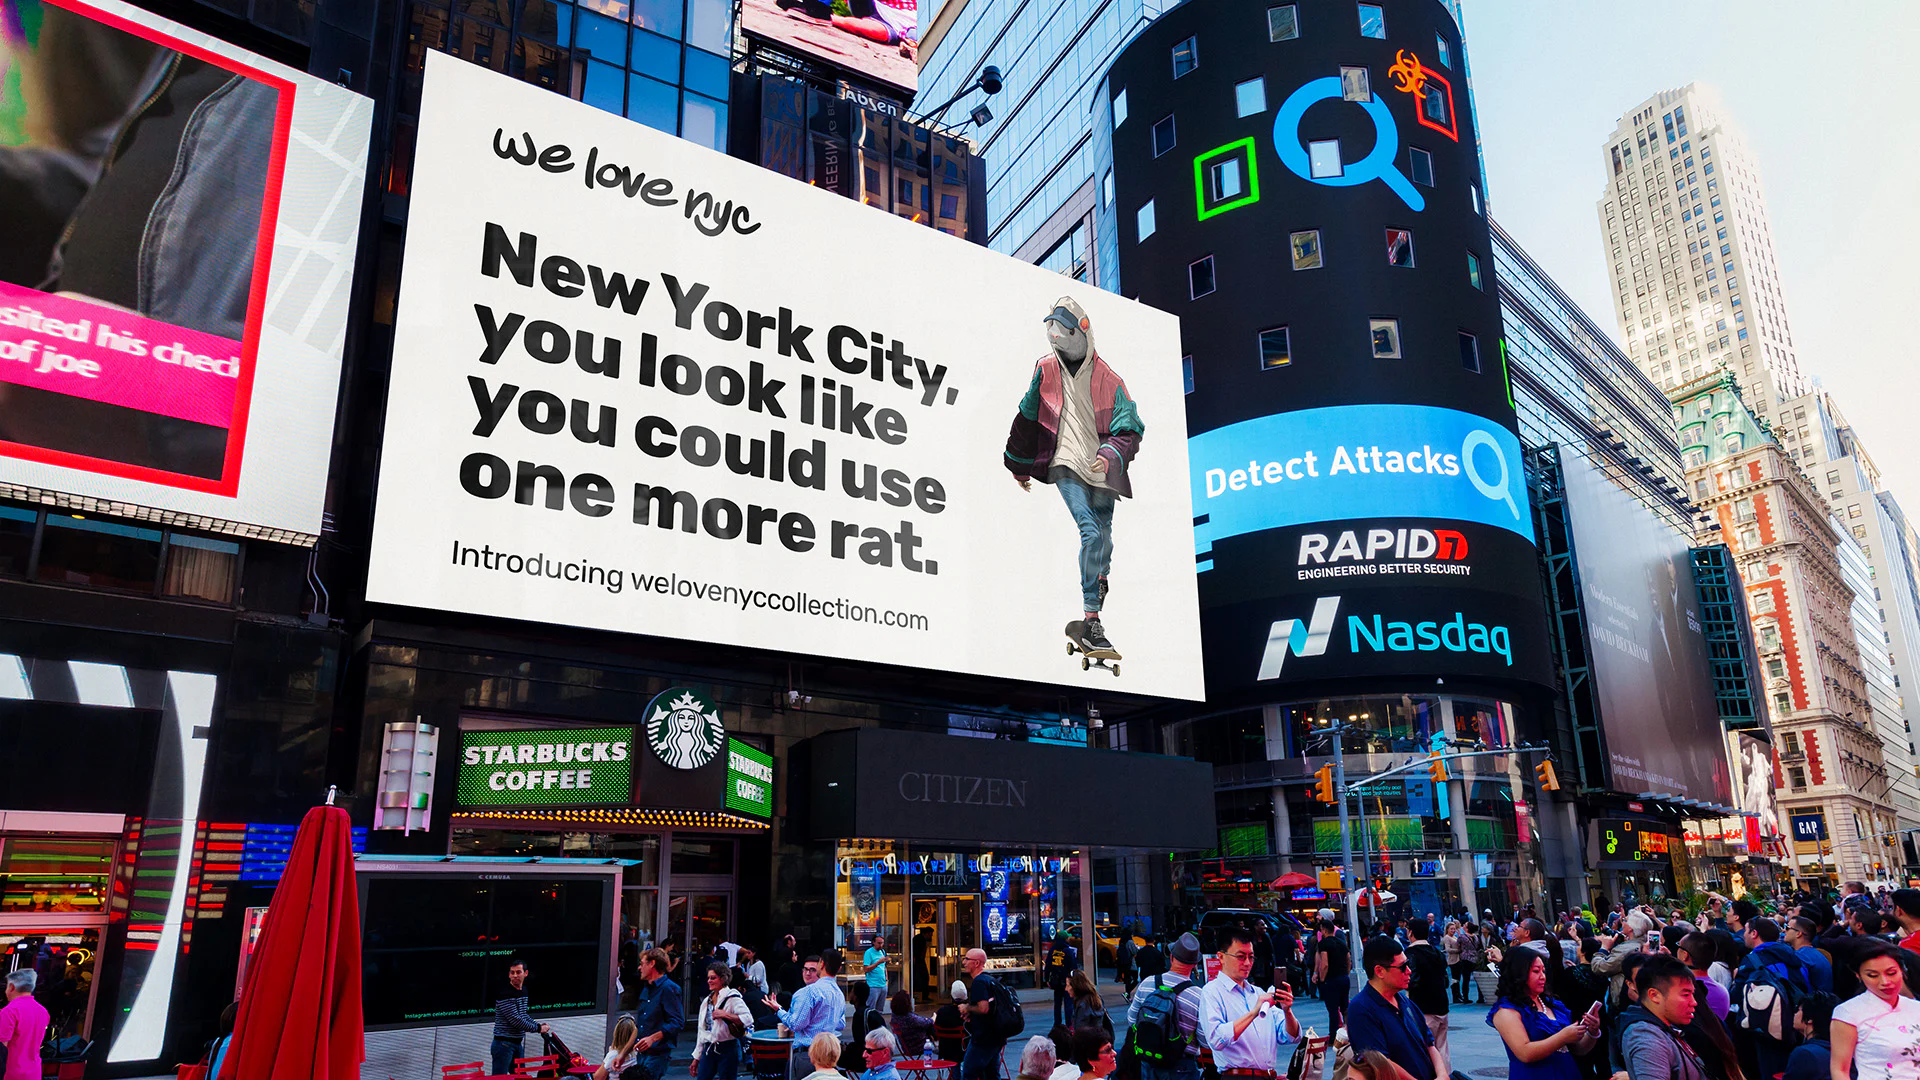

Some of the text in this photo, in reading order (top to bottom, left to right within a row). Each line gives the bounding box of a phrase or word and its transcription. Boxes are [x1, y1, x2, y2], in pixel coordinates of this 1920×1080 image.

[845, 89, 897, 118] Absen
[493, 128, 761, 236] we love nyc
[481, 222, 958, 406] New York City,
[95, 323, 148, 356] his
[0, 340, 101, 378] of joe
[474, 304, 907, 445] you look like
[467, 375, 946, 514] you could use
[1206, 446, 1459, 498] Detect Attacks
[460, 453, 938, 575] one more rat.
[453, 541, 928, 630] Introducing welovenyccollection.com
[1298, 563, 1471, 581] ENGINEERING BETTER SECURITY
[1348, 612, 1513, 667] Nasdaq
[1592, 623, 1650, 664] DAVID BECKHAM
[464, 742, 627, 765] STARBUCKS
[729, 751, 773, 784] STARBUCKS
[488, 769, 592, 791] COFFEE
[736, 779, 765, 804] COFFEE
[899, 771, 1029, 807] CITIZEN
[1798, 820, 1818, 835] GAP
[923, 873, 969, 887] CITIZEN
